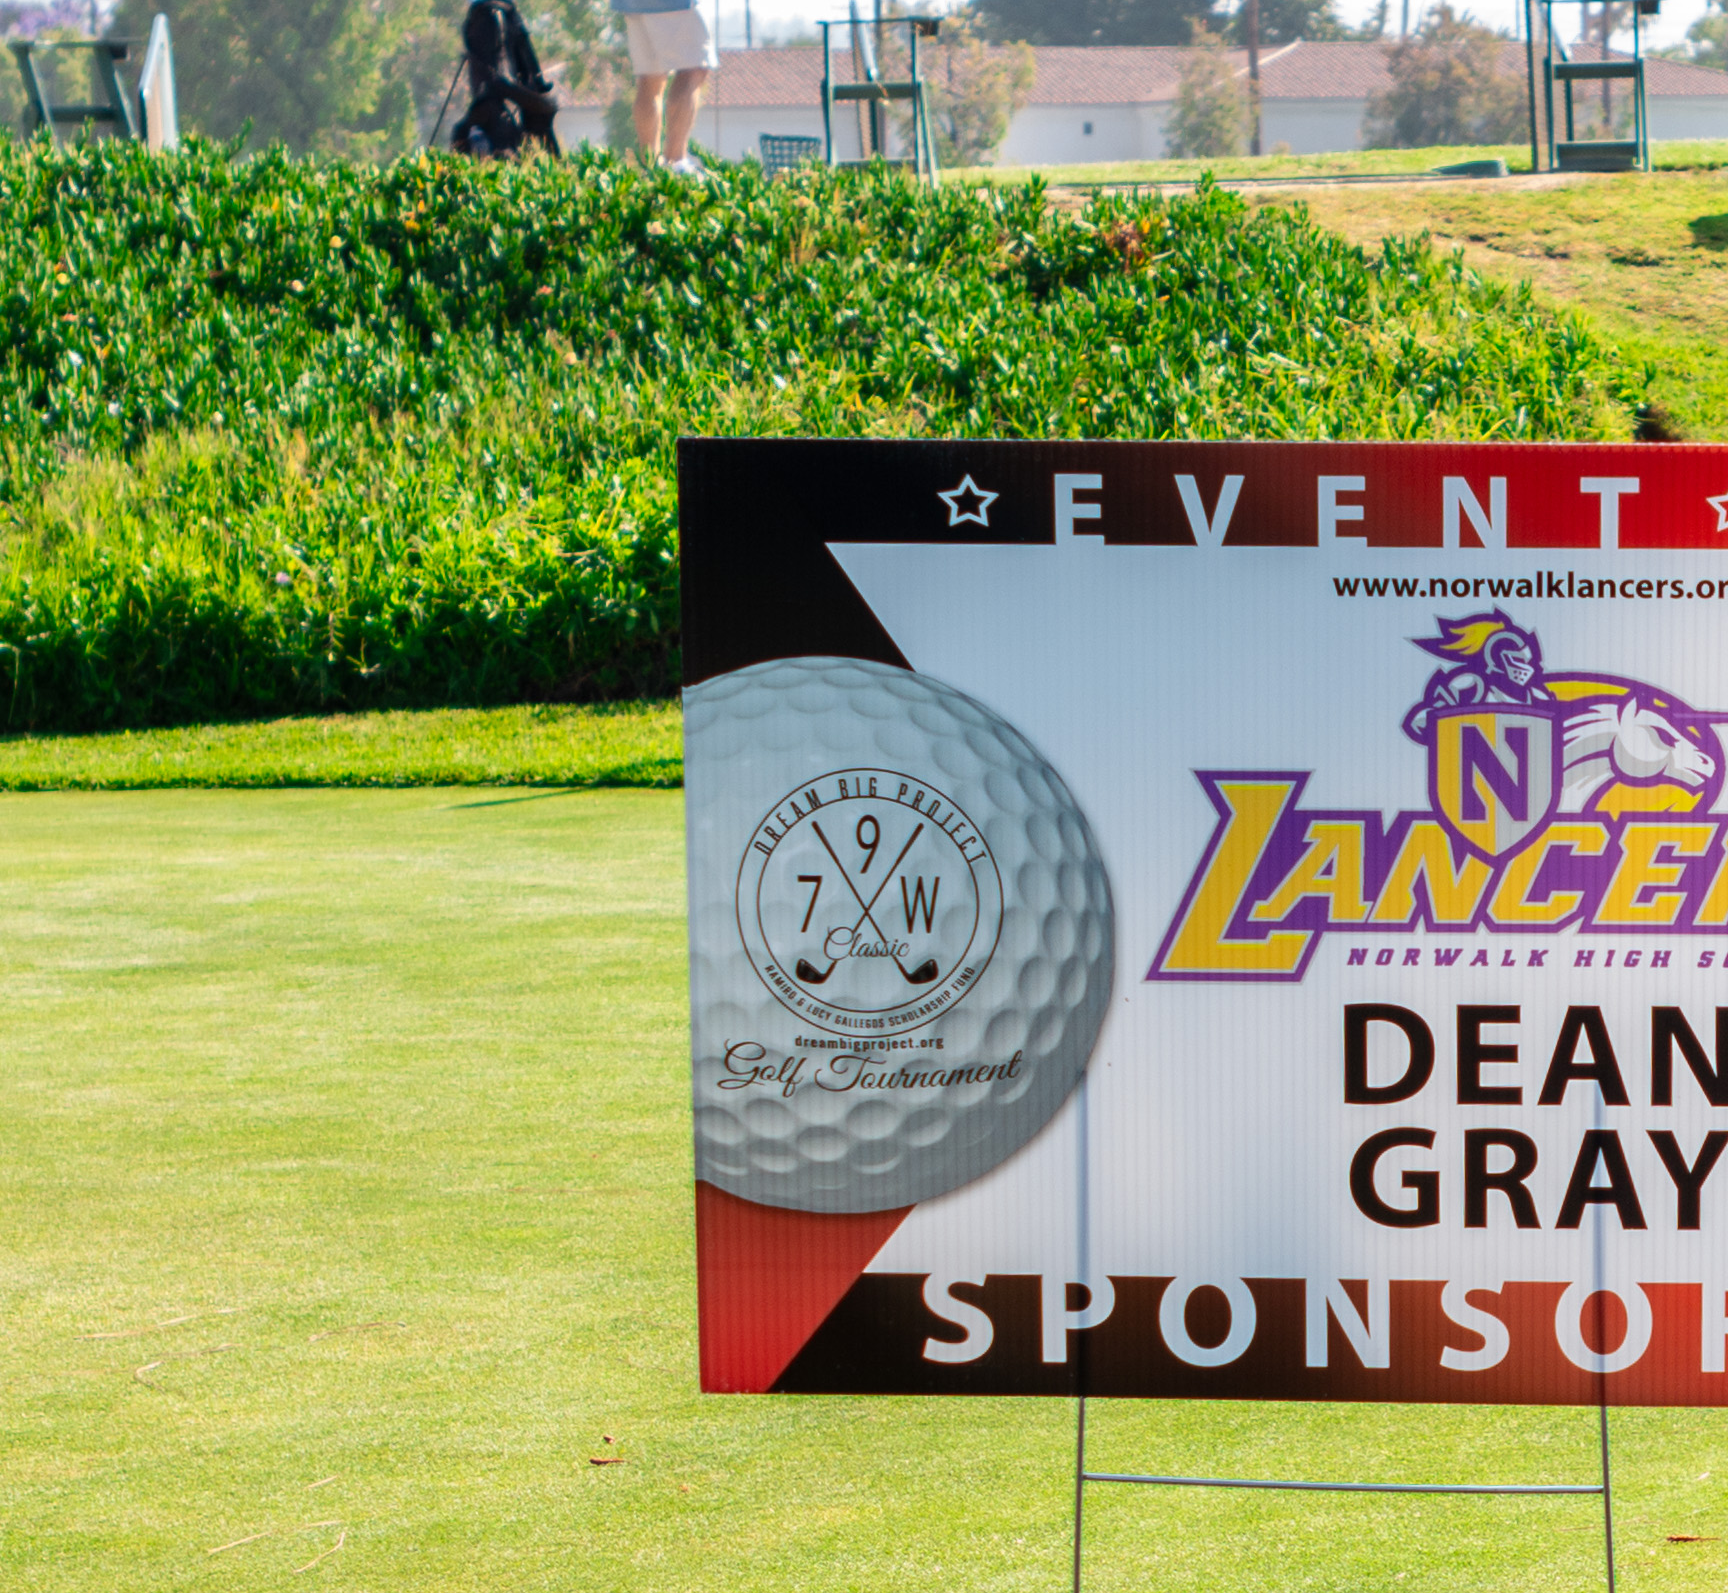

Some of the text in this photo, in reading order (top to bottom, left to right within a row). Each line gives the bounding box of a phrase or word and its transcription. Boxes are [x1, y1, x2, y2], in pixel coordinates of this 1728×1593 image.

[1053, 472, 1641, 549] EVENT
[1460, 721, 1528, 825] N
[753, 776, 988, 865] DREAM BIG PROJECT
[855, 814, 882, 875] 9
[797, 874, 941, 934] 7 W
[823, 926, 911, 961] Classic
[1346, 947, 1551, 969] NORWALK
[1574, 949, 1673, 970] HIGH
[764, 964, 797, 1000] RAMIRO
[806, 1002, 832, 1022] LUCY
[834, 1014, 886, 1030] GALLEGOS
[887, 990, 953, 1028] SCHOLARSHIP
[951, 965, 977, 993] FUND
[716, 1037, 1024, 1098] Golf Tournament
[795, 1035, 945, 1053] dreambigproject.org
